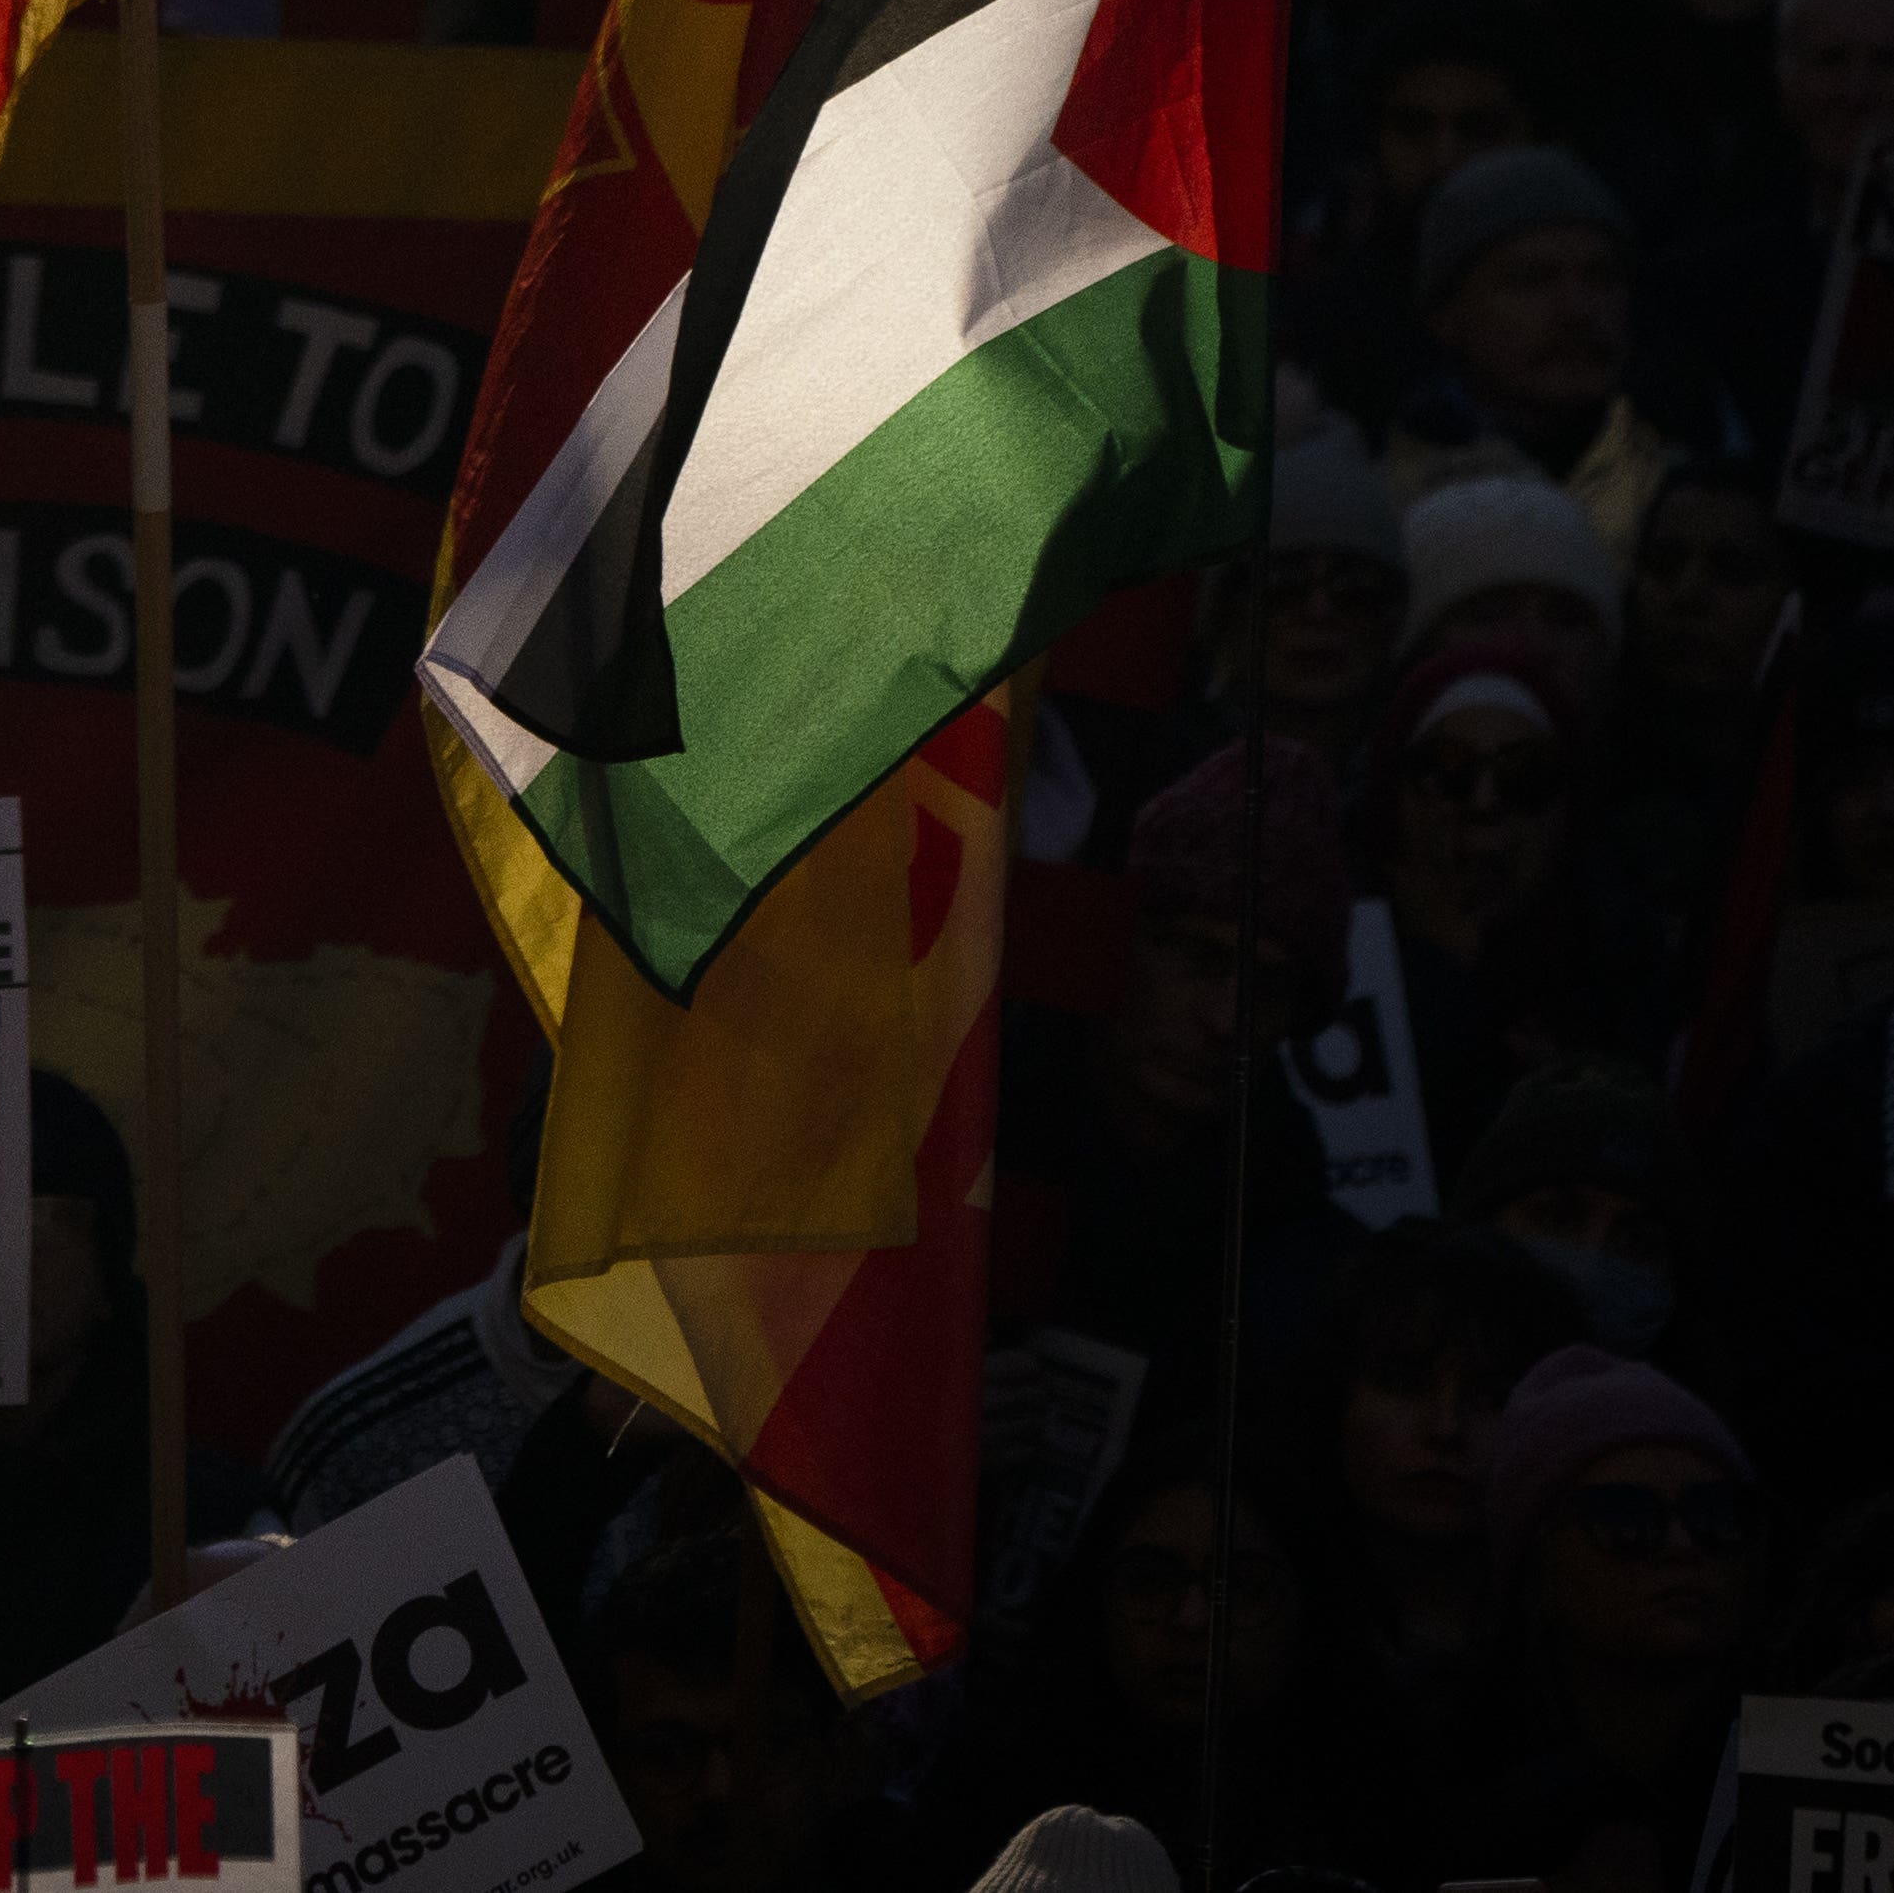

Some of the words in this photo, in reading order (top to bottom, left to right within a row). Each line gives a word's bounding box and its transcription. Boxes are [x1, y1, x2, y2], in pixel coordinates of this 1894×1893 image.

[270, 294, 462, 478] TO
[267, 1568, 529, 1802] za
[57, 1743, 221, 1886] THE
